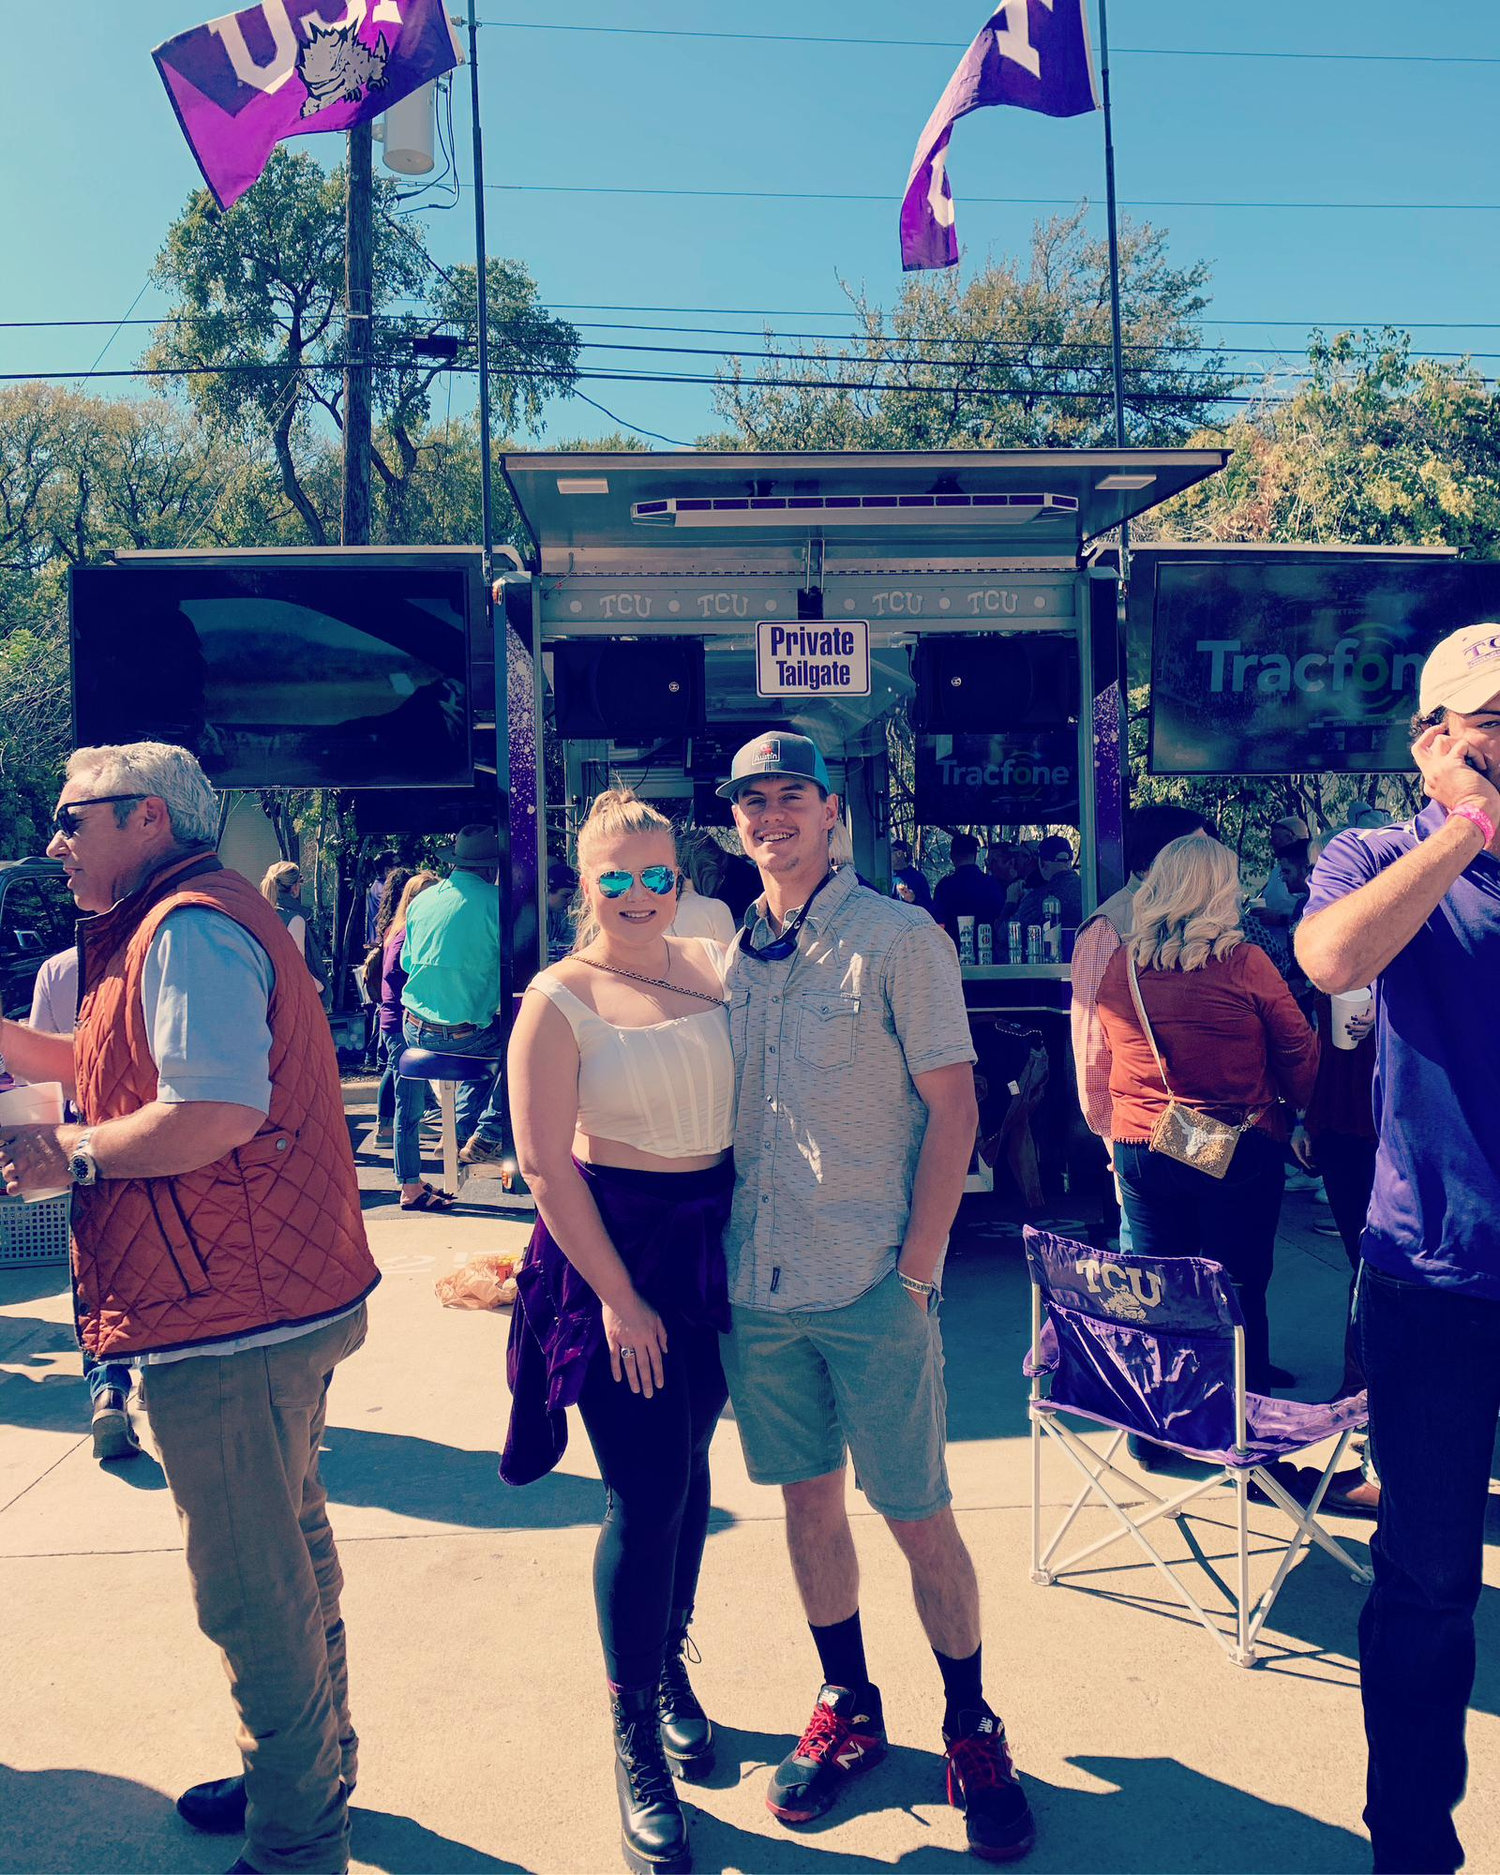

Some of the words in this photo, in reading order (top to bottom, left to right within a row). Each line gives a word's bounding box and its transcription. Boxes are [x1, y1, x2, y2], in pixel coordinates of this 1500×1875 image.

[601, 593, 652, 617] TCU
[697, 592, 748, 617] TCU
[872, 591, 923, 615] TCU
[967, 590, 1018, 614] TCU
[770, 626, 854, 656] Private
[775, 660, 850, 690] Tailgate
[1196, 638, 1425, 692] Tracfon
[936, 759, 1069, 785] Tracfone
[1076, 1260, 1161, 1307] TCU
